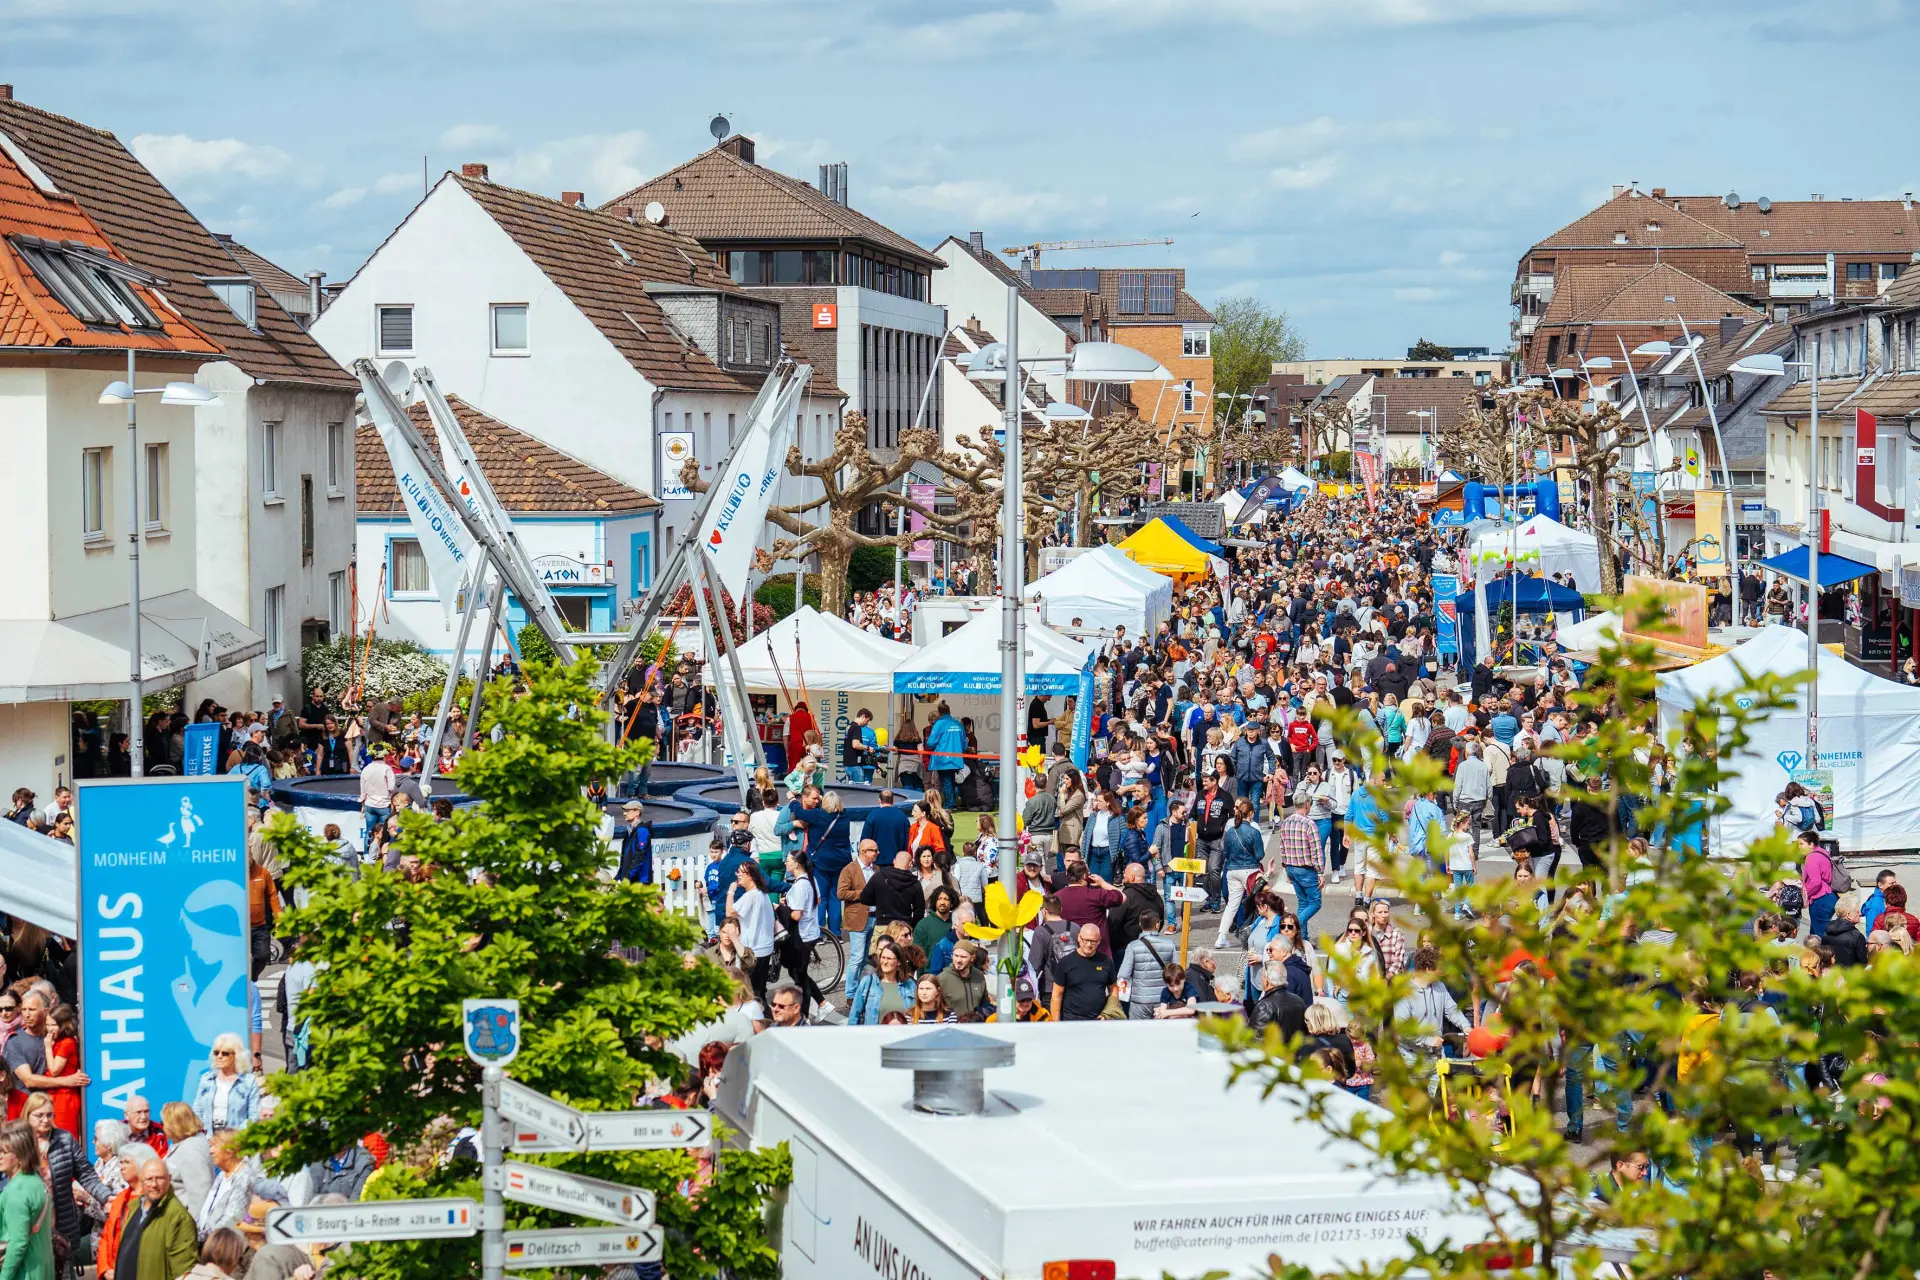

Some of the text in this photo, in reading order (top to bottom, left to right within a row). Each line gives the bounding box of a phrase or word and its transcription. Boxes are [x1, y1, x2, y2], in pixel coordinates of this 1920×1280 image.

[759, 468, 778, 499] ERKE
[401, 472, 464, 563] KULTURWERKE
[423, 479, 460, 535] MONHEIMER
[707, 473, 751, 554] I KULTUR
[536, 569, 579, 581] LATON
[963, 682, 1002, 690] KULTURWER
[835, 690, 850, 784] KULTURWER
[1806, 751, 1863, 761] ONHEIMER
[94, 851, 167, 867] MONHEIM
[192, 849, 237, 863] RHEIN
[98, 892, 146, 1119] ATHAUS
[317, 1215, 401, 1231] Bourg-la-Reine
[1133, 1219, 1157, 1231] WIR
[1160, 1217, 1207, 1231] FAHREN
[1209, 1216, 1243, 1229] AUCH
[1245, 1214, 1269, 1227] FÜR
[1271, 1213, 1292, 1226] IHR
[1294, 1211, 1352, 1225] CATERING
[1354, 1210, 1401, 1223] EINIGES
[527, 1243, 582, 1256] Delitzsch
[854, 1215, 872, 1263] AN
[874, 1231, 900, 1280] UNS
[1134, 1231, 1311, 1252] buffet@catering-monheim.de
